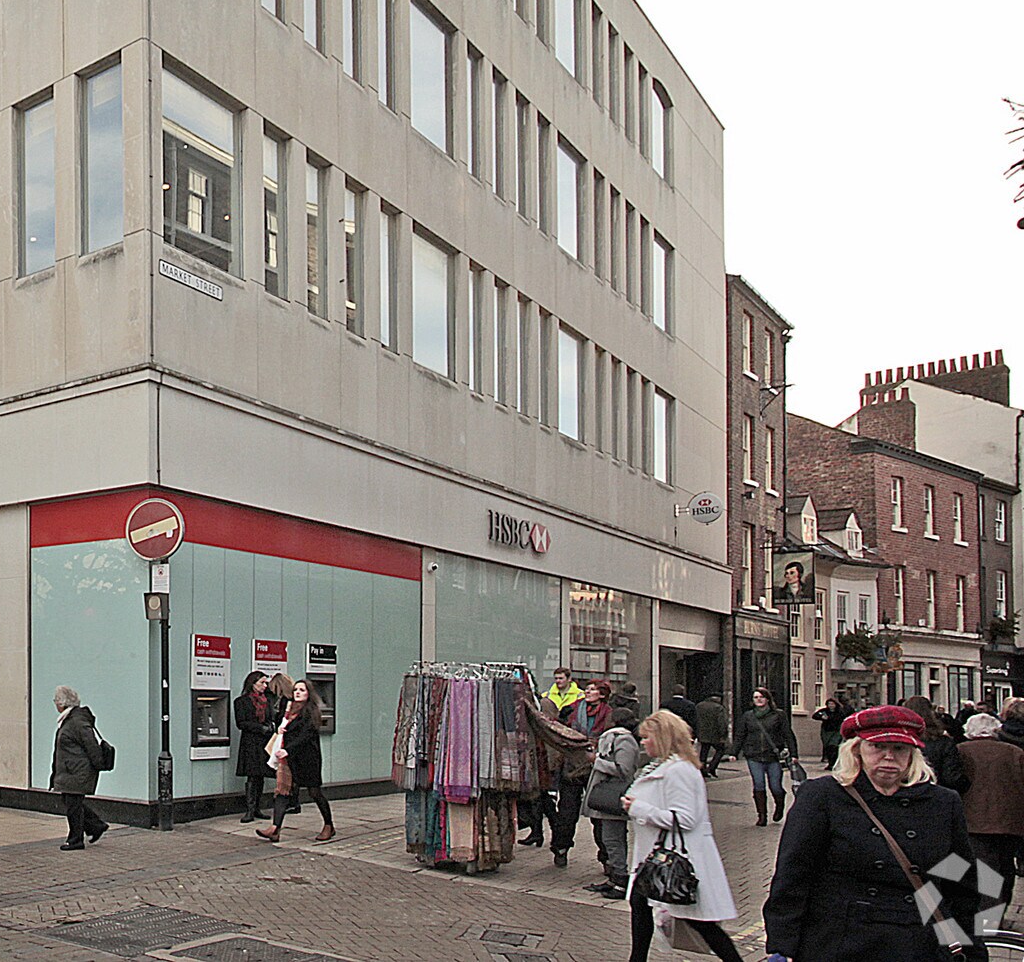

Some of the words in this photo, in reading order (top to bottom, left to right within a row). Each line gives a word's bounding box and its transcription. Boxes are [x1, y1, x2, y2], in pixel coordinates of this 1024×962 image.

[162, 263, 192, 284] MARKET
[196, 278, 220, 297] STREET
[692, 506, 719, 516] HSBC
[487, 509, 530, 549] HSBC
[197, 638, 210, 647] Free
[257, 642, 268, 652] Free
[310, 646, 319, 656] Pay
[319, 646, 325, 654] in
